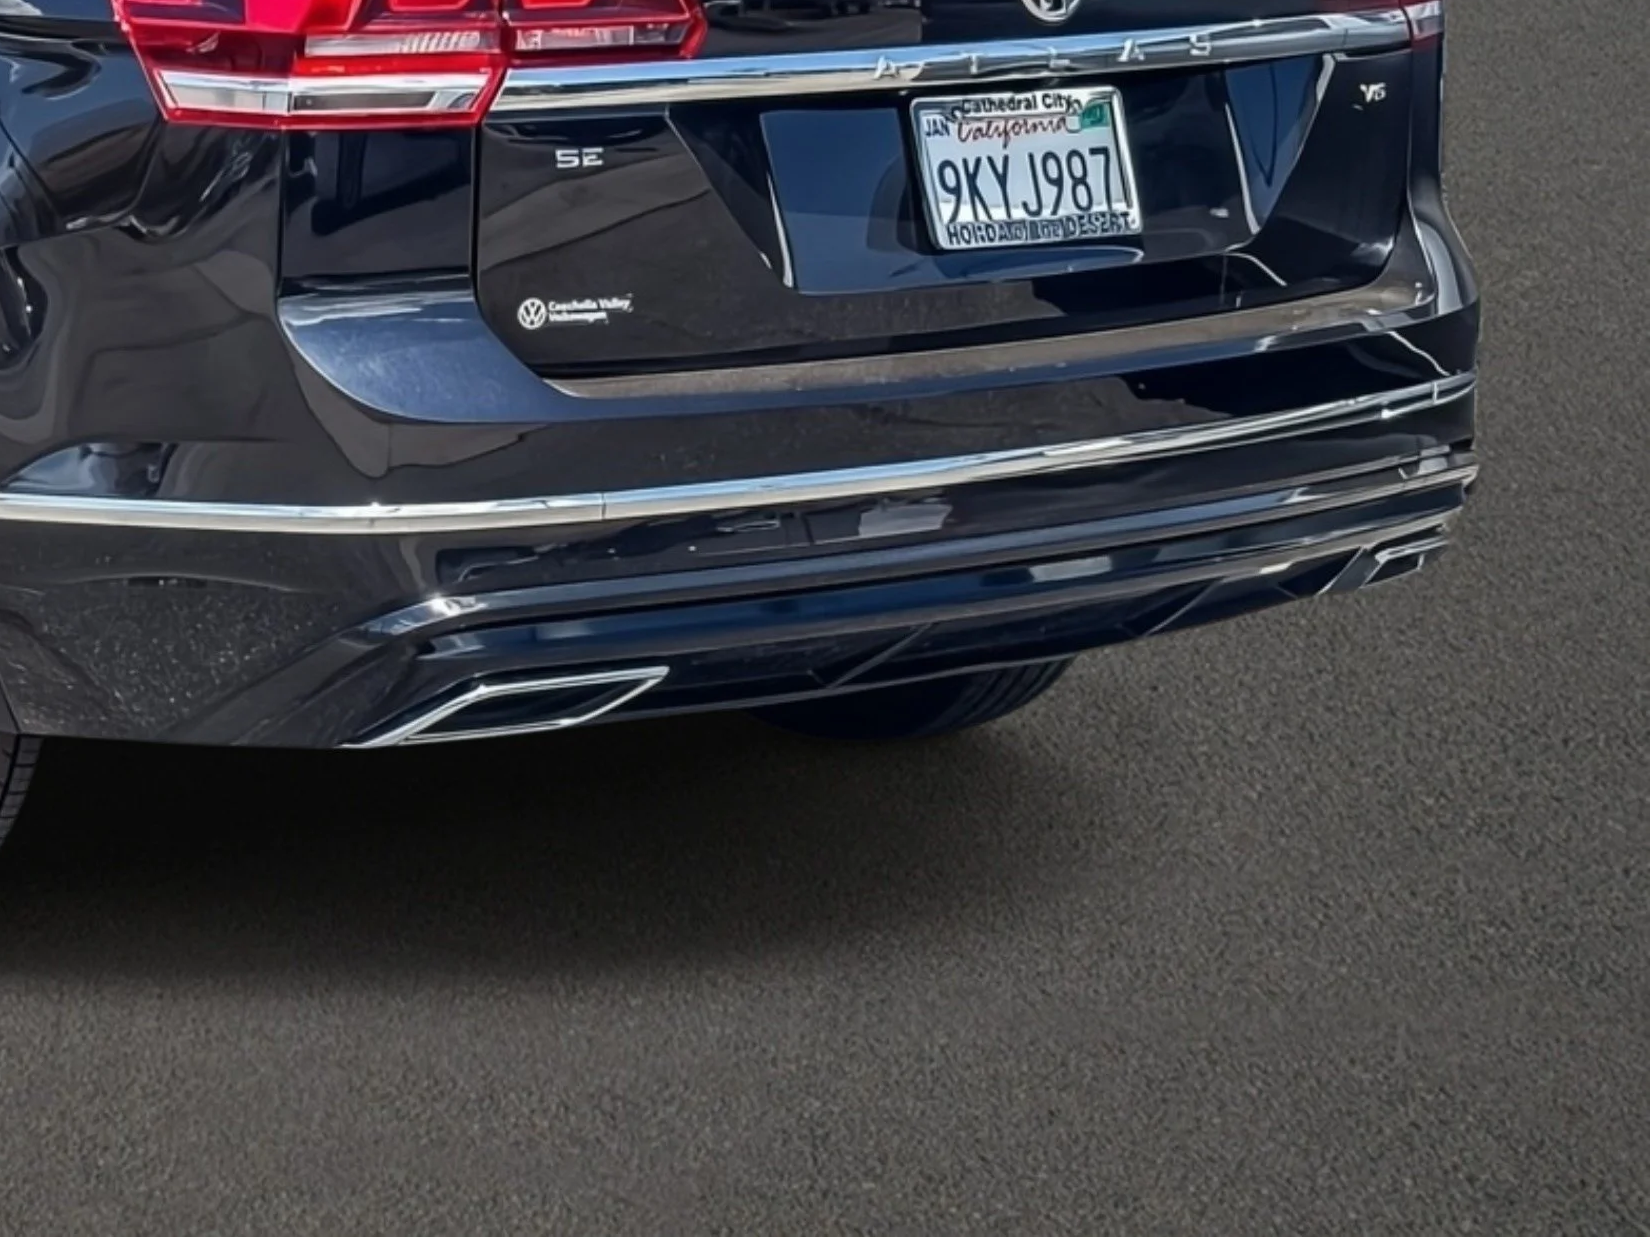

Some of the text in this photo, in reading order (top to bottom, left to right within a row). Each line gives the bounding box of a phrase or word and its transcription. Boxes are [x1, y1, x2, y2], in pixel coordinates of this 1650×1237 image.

[961, 92, 1074, 114] Cathedral City
[1359, 82, 1387, 103] V6
[957, 115, 1066, 149] California
[555, 147, 604, 169] SE
[937, 146, 1114, 224] 9KYJ987
[946, 219, 1008, 247] HONDA
[1063, 211, 1131, 237] DESERT
